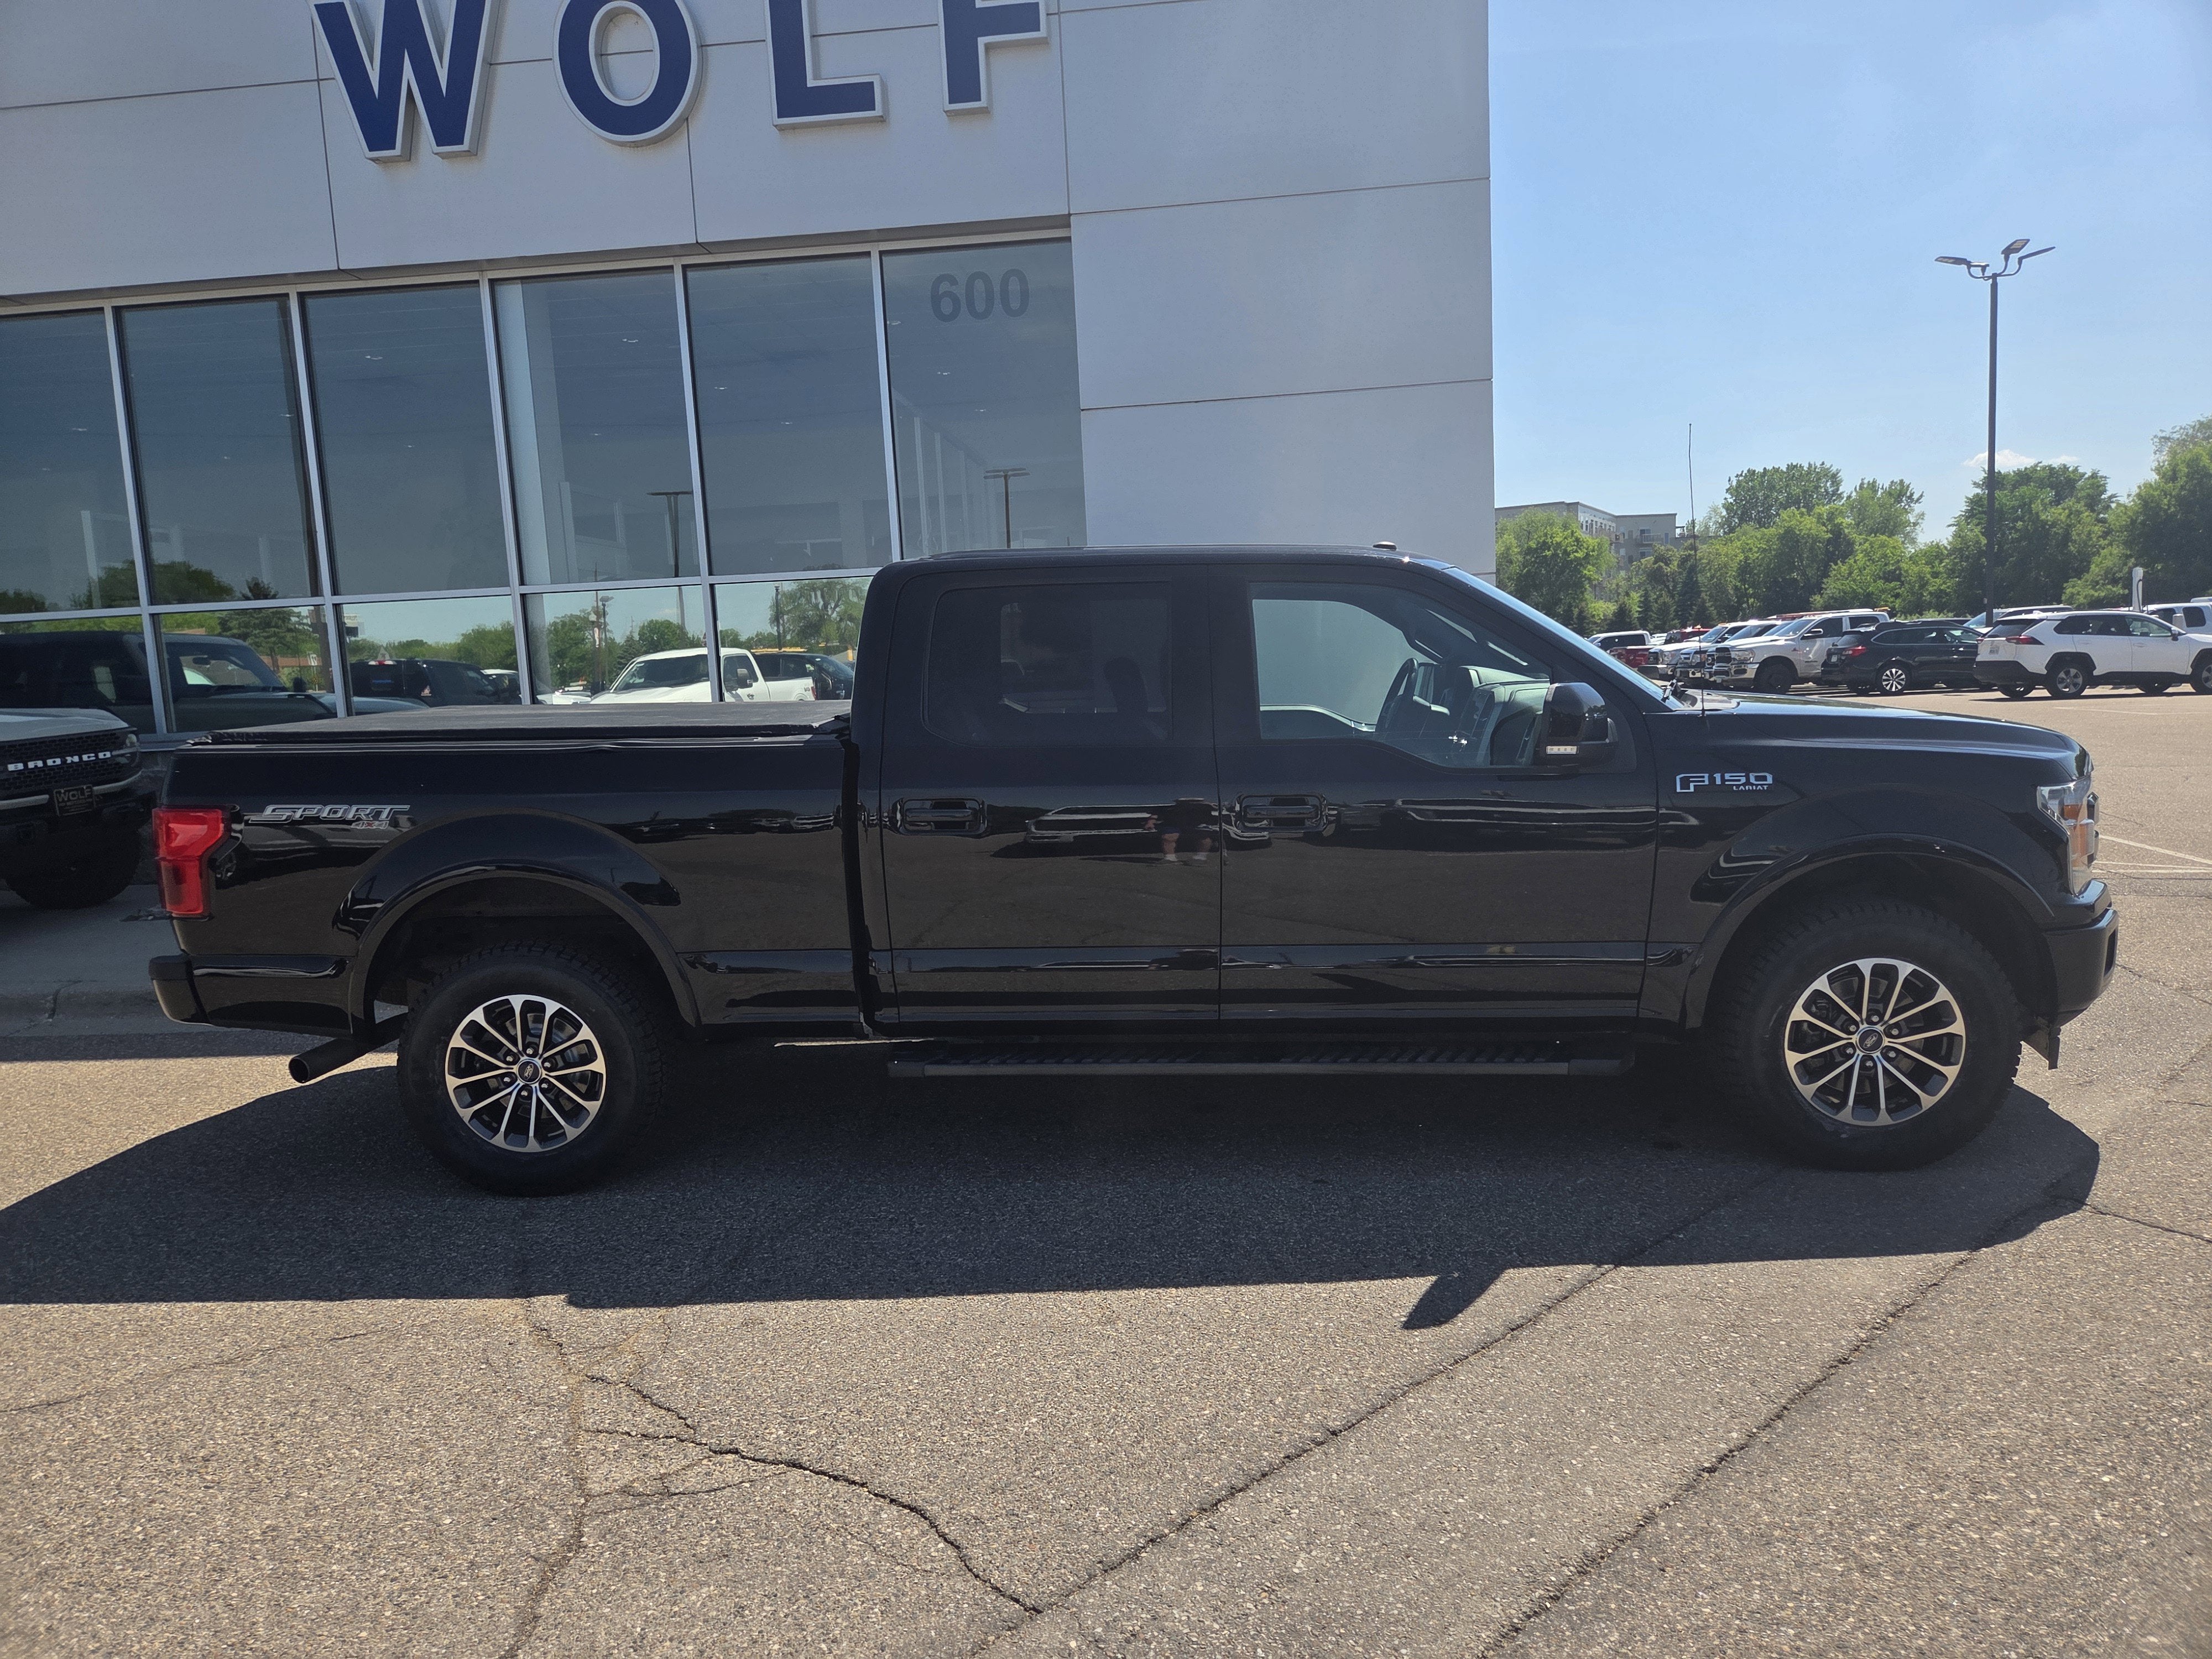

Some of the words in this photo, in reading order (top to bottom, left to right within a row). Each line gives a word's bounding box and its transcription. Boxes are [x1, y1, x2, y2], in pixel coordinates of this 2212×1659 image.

[310, 0, 1048, 161] WOLF
[931, 268, 1030, 323] 600
[8, 752, 111, 771] BRONCO
[56, 788, 91, 802] WOLF
[249, 805, 410, 823] SPORT
